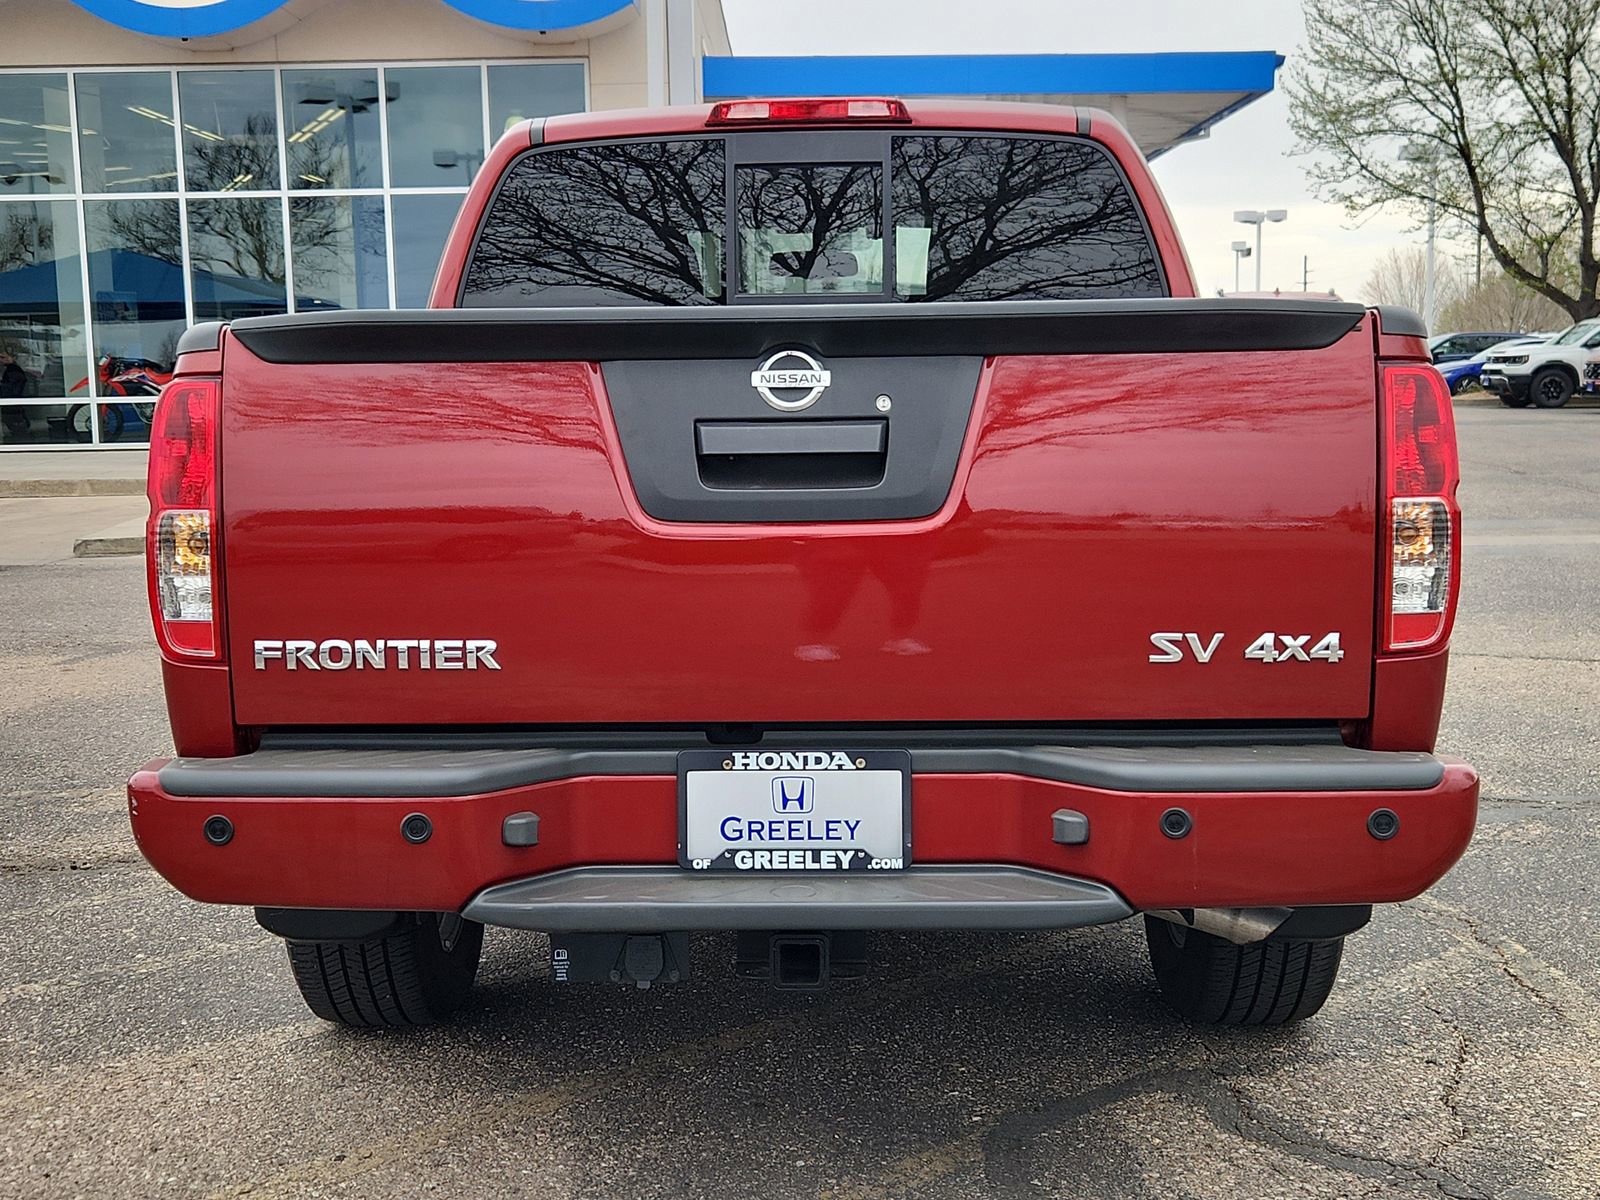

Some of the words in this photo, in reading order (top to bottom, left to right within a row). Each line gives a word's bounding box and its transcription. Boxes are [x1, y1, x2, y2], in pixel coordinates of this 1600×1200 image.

[760, 373, 822, 384] NISSAN
[253, 639, 502, 671] FRONTIER
[1148, 632, 1225, 663] SV
[731, 751, 857, 770] HONDA
[692, 858, 712, 870] OF
[733, 850, 855, 870] GREELEY
[867, 858, 904, 870] .COM
